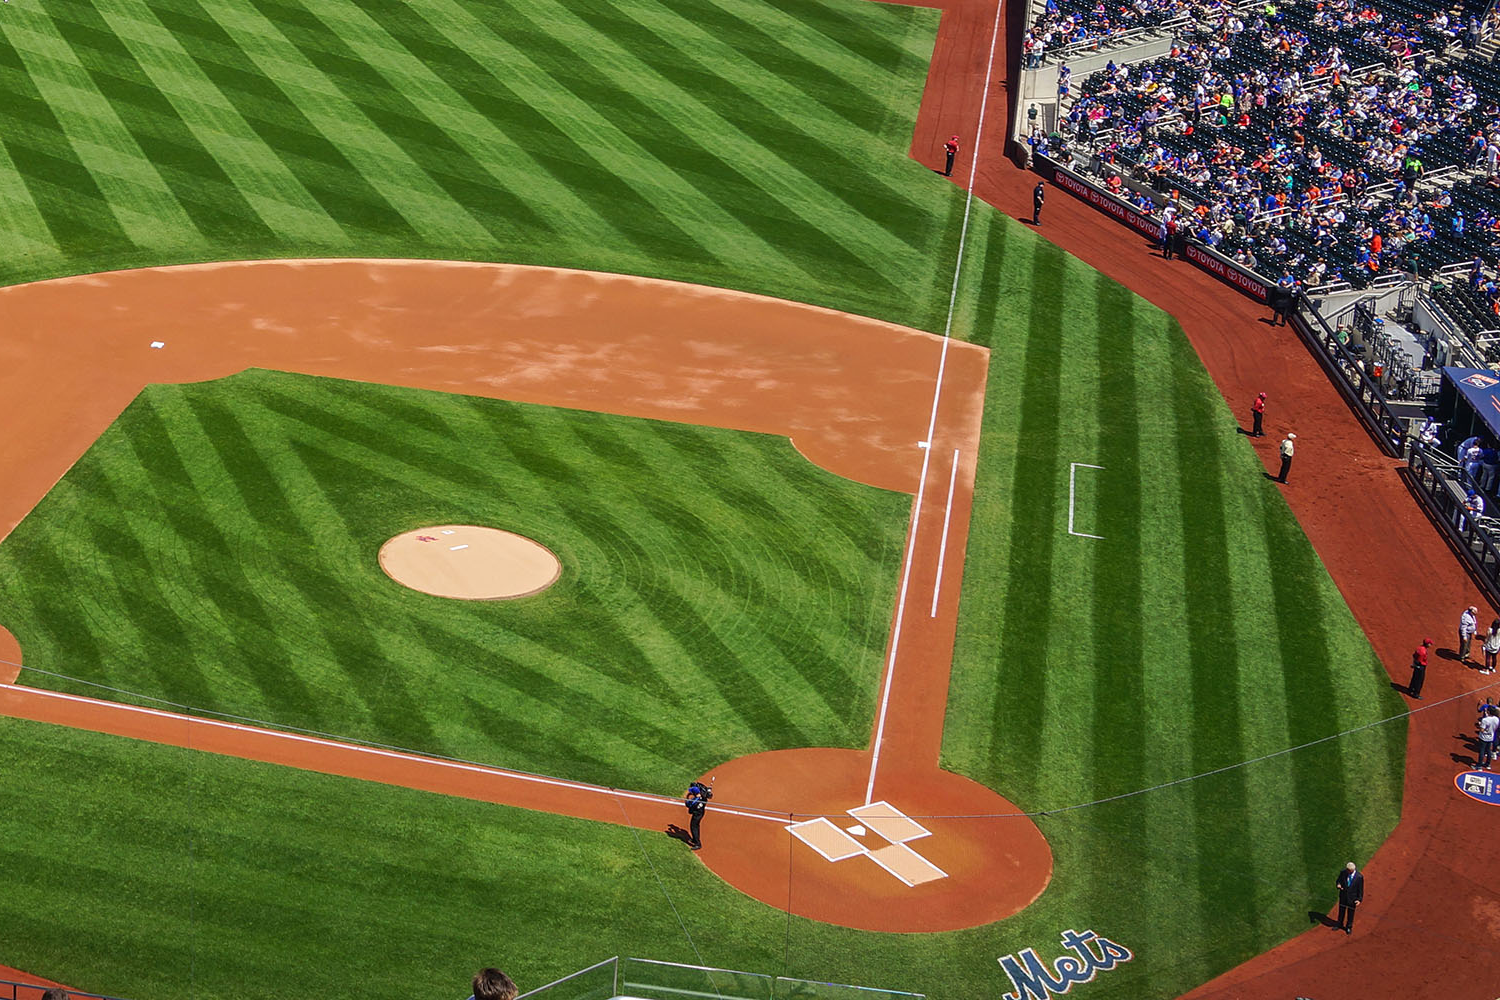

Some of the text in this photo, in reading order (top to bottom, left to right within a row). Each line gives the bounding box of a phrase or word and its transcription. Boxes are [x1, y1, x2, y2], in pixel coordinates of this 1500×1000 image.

[1063, 173, 1088, 196] TOYOTA
[1099, 195, 1124, 217] TOYOTA
[1197, 248, 1224, 275] TOYOTA
[997, 929, 1134, 1000] Mets
